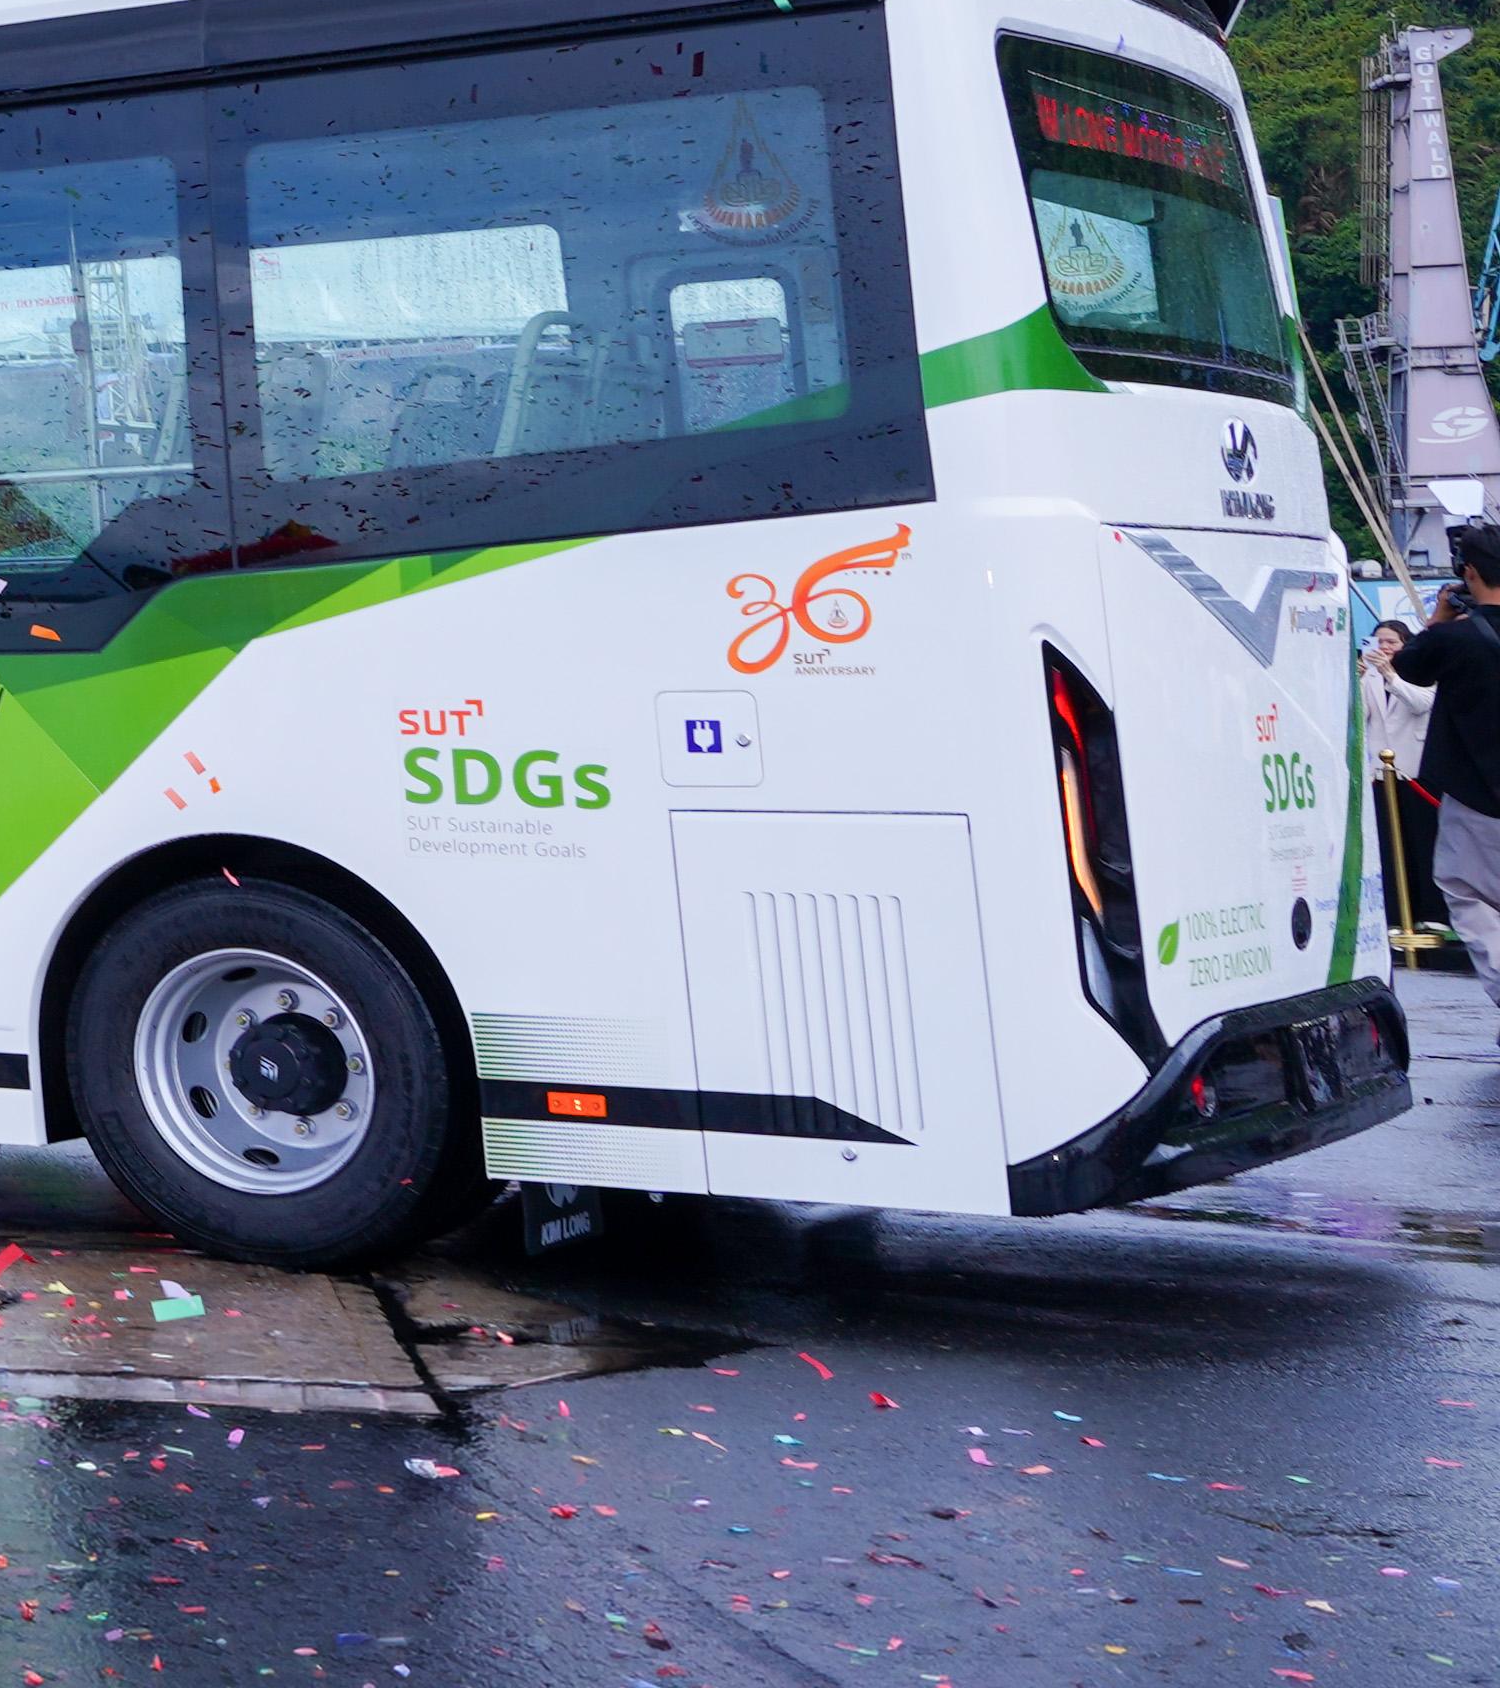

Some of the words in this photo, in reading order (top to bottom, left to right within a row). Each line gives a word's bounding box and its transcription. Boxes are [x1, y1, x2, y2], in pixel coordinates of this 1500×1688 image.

[1415, 46, 1449, 179] GOTTWALD
[793, 652, 827, 665] SUT
[794, 666, 877, 676] ANNIVERSARY
[398, 710, 472, 737] SUT
[403, 746, 612, 810] SDGs
[1262, 751, 1316, 813] SDGs
[406, 815, 442, 832] SUT
[448, 816, 553, 836] Sustainable
[409, 837, 528, 857] Development
[534, 841, 588, 859] Goals
